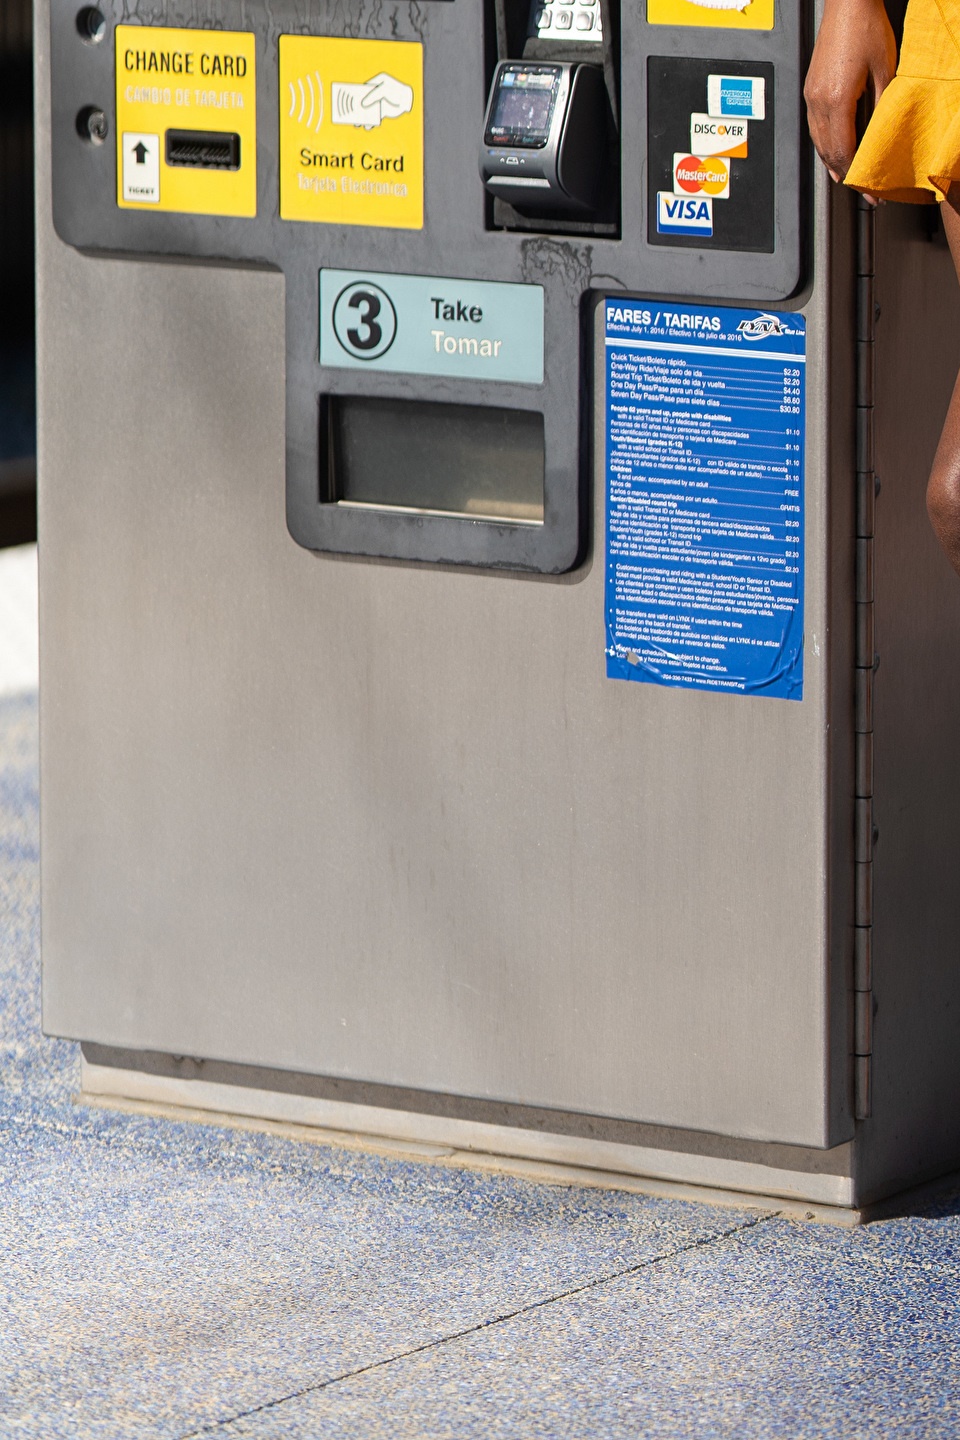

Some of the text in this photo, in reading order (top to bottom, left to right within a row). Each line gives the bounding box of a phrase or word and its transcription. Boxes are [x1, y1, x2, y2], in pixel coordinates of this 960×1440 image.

[124, 49, 247, 77] CHANGE CARD
[124, 86, 244, 109] CAMBIO DE TARJETA
[694, 123, 744, 136] DISCOVER
[299, 148, 405, 173] Smart Card
[298, 172, 408, 197] Tarjeta Electronica
[677, 168, 727, 184] MasterCard
[128, 186, 154, 196] TICKET
[664, 200, 711, 220] VISA
[347, 291, 382, 350] 3
[430, 297, 483, 325] Take
[606, 307, 651, 325] FARES
[662, 312, 720, 331] TARIFAS
[606, 322, 630, 331] Effective
[630, 325, 642, 333] July
[650, 326, 664, 334] 2016
[668, 327, 691, 337] Efectivo
[705, 331, 718, 340] julio
[718, 332, 726, 340] de
[727, 333, 742, 341] 2016
[736, 320, 788, 336] LYNX
[431, 330, 501, 357] Tomar
[610, 352, 627, 361] Quick
[783, 367, 800, 377] $2.20
[610, 361, 638, 372] One-Way
[683, 368, 692, 376] de
[693, 369, 702, 377] ida
[783, 377, 800, 386] $2.20
[610, 370, 630, 379] Round
[630, 372, 642, 382] Trip
[682, 377, 690, 385] de
[691, 378, 701, 386] ida
[707, 380, 725, 388] vuelta
[783, 386, 800, 395] $4.40
[610, 379, 623, 388] One
[623, 381, 636, 390] Day
[669, 386, 683, 395] para
[783, 395, 800, 405] $6.60
[610, 389, 629, 398] Seven
[629, 390, 642, 400] Day
[675, 396, 690, 405] para
[779, 404, 800, 414] $30.80
[610, 404, 628, 413] People
[671, 410, 690, 419] people
[690, 411, 702, 419] with
